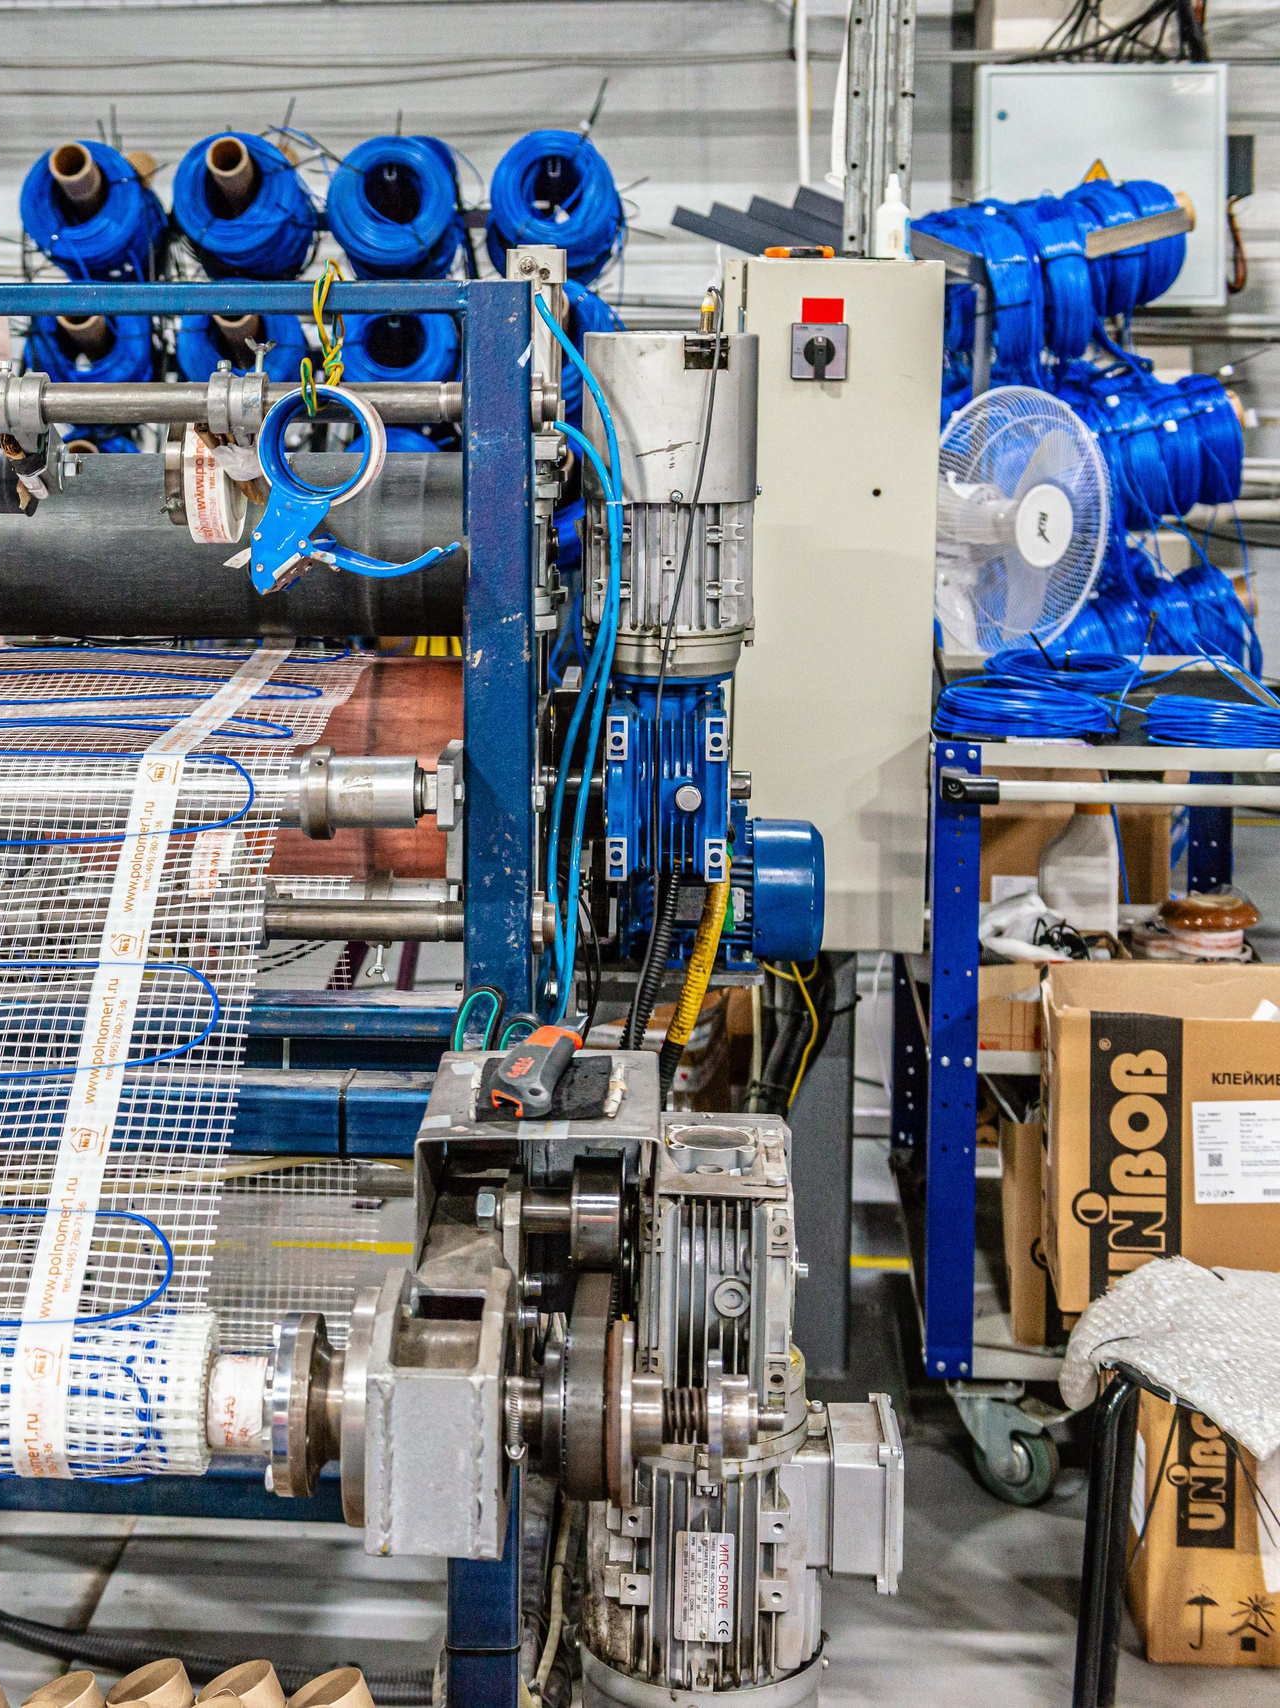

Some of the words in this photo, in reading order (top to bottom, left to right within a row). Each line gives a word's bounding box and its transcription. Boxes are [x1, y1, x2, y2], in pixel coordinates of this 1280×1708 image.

[123, 800, 156, 912] www.polnomer1.ru
[150, 819, 163, 854] 780-71-36
[146, 856, 156, 874] (495)
[84, 978, 120, 1104] www.polnomer1.ru
[111, 999, 128, 1040] 780-71-36
[108, 1041, 120, 1062] (495)
[69, 1201, 88, 1246] 780-71-36
[40, 1176, 78, 1320] www.polnomer1.ru
[64, 1248, 79, 1272] (495)
[1166, 1411, 1228, 1531] UNIBO
